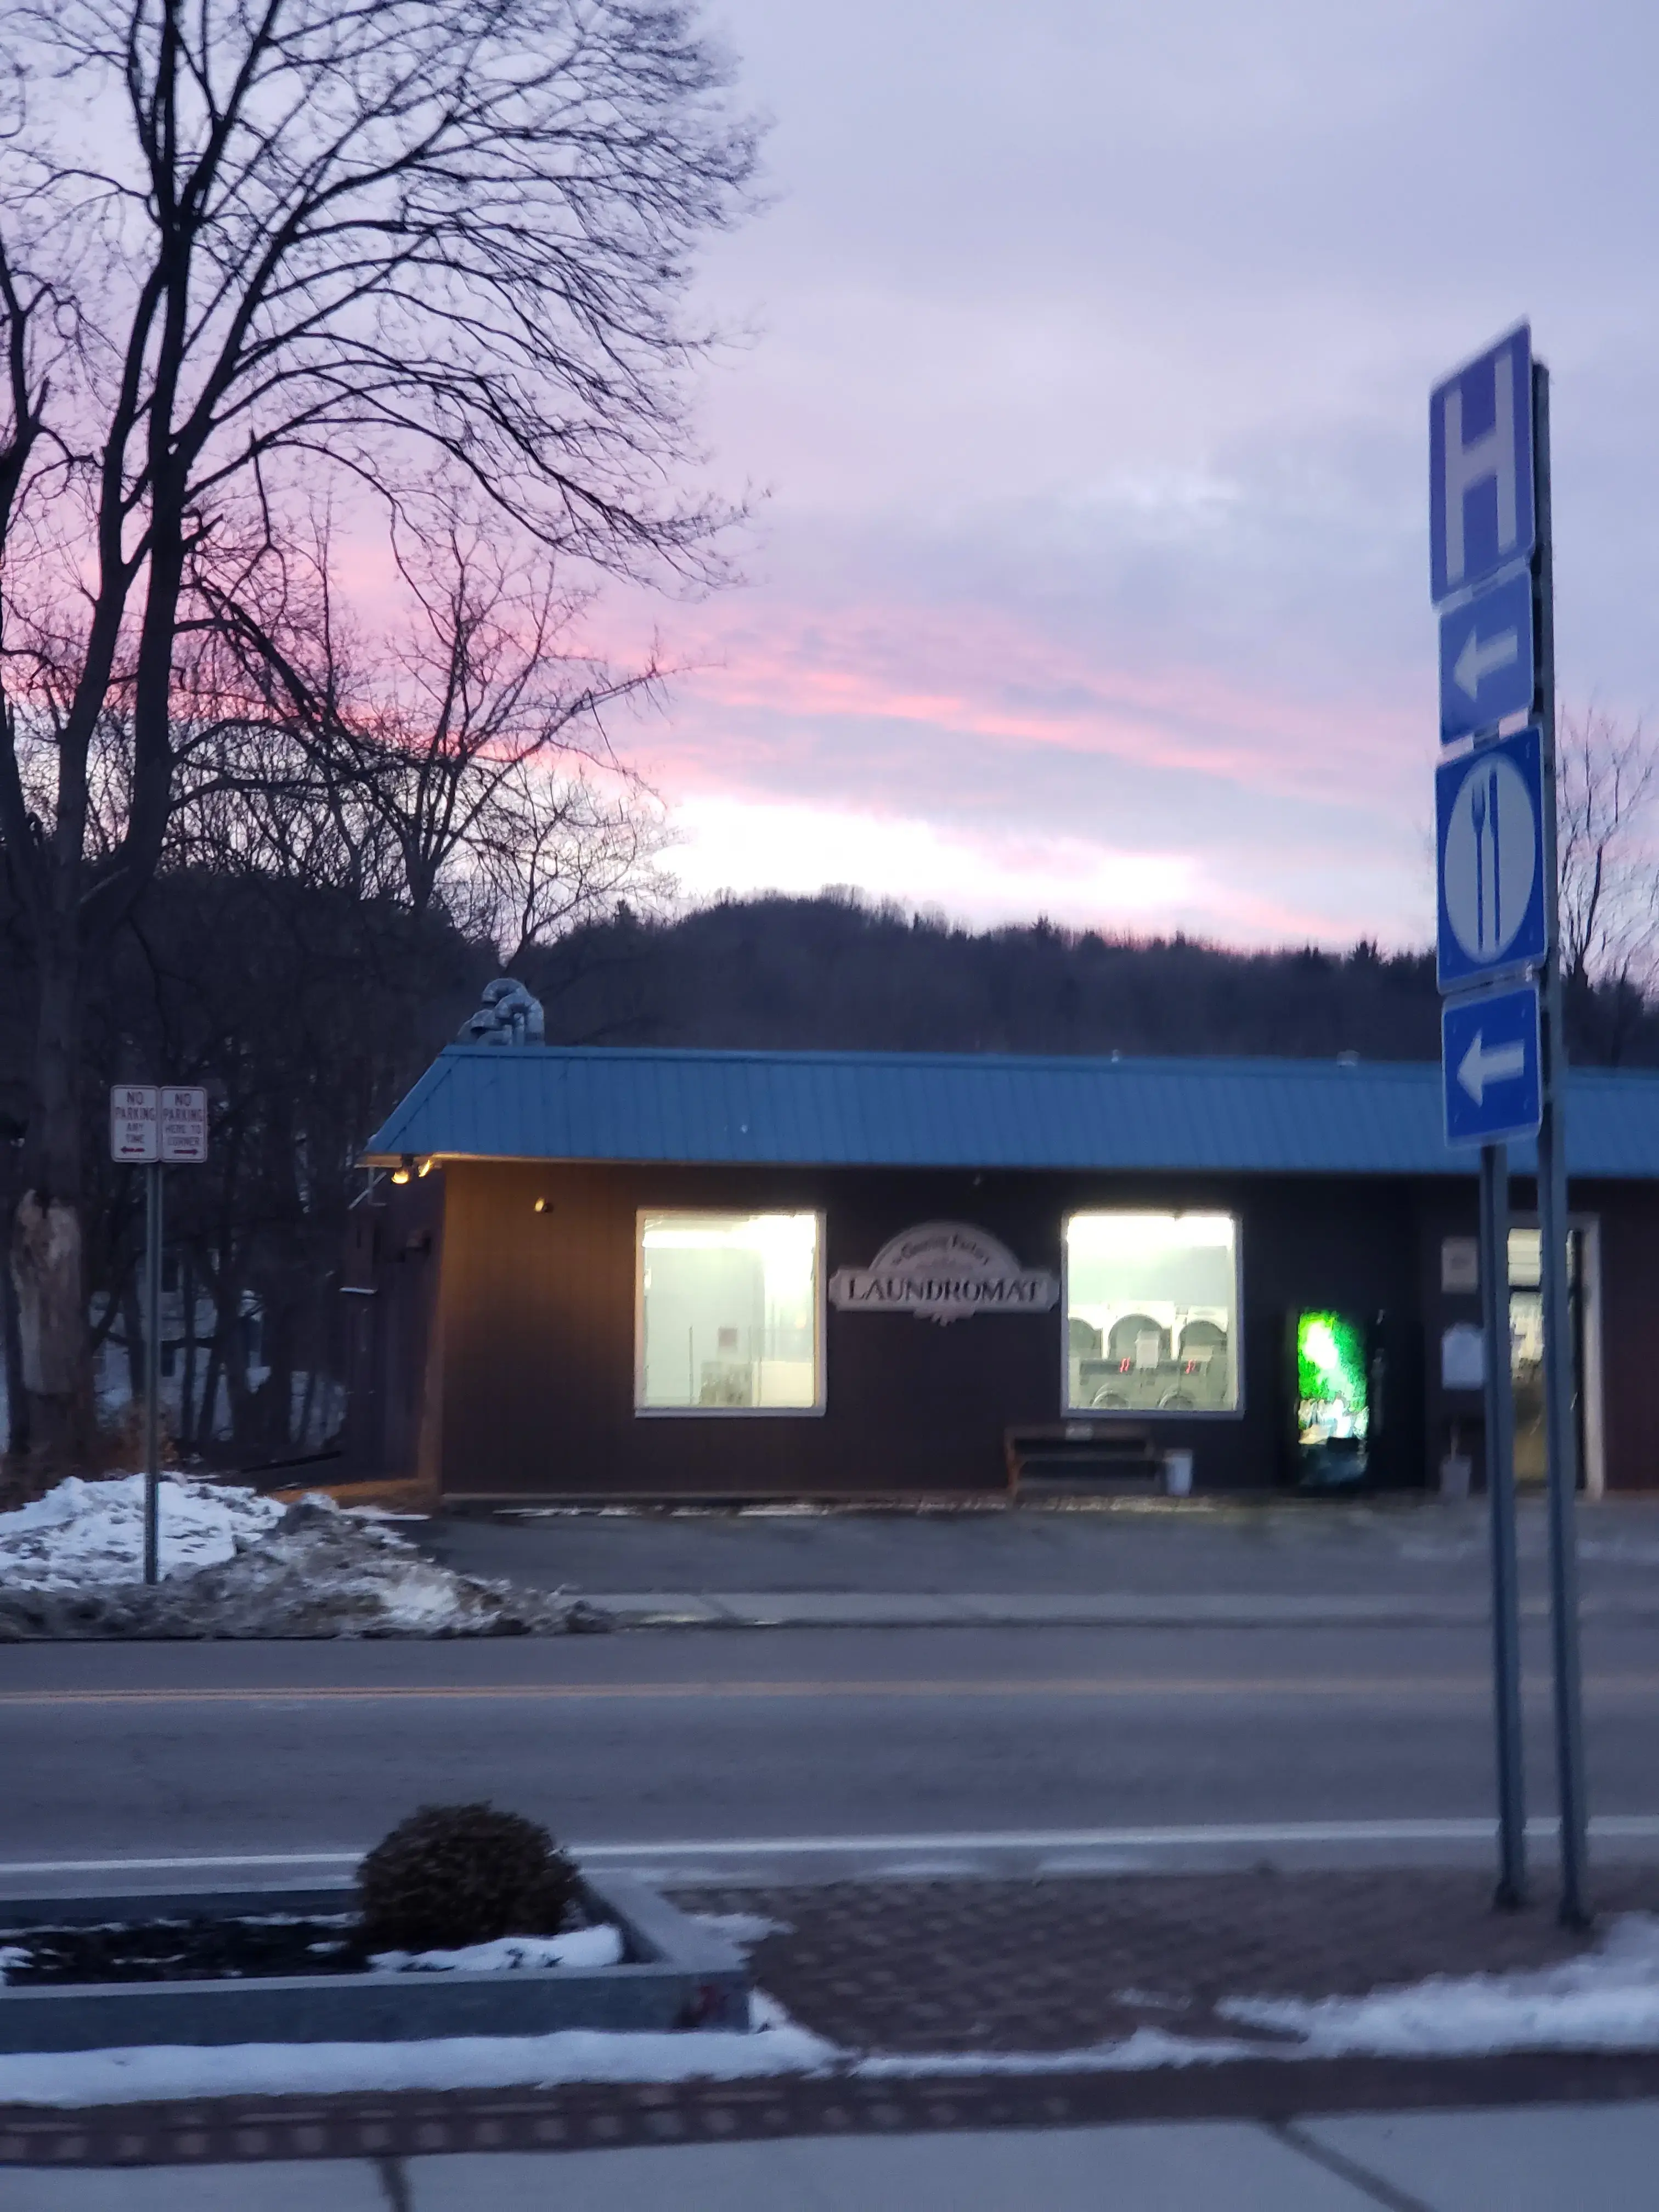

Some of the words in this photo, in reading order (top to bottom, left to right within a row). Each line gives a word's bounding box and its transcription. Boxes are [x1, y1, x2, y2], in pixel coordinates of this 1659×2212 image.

[1445, 354, 1516, 585] H
[127, 1091, 144, 1105] NO
[174, 1093, 192, 1107] NO
[116, 1107, 156, 1121] PARKING
[163, 1108, 204, 1122] PARKING
[127, 1122, 144, 1132] ANY
[848, 1278, 1040, 1302] LAUNDROMAT
